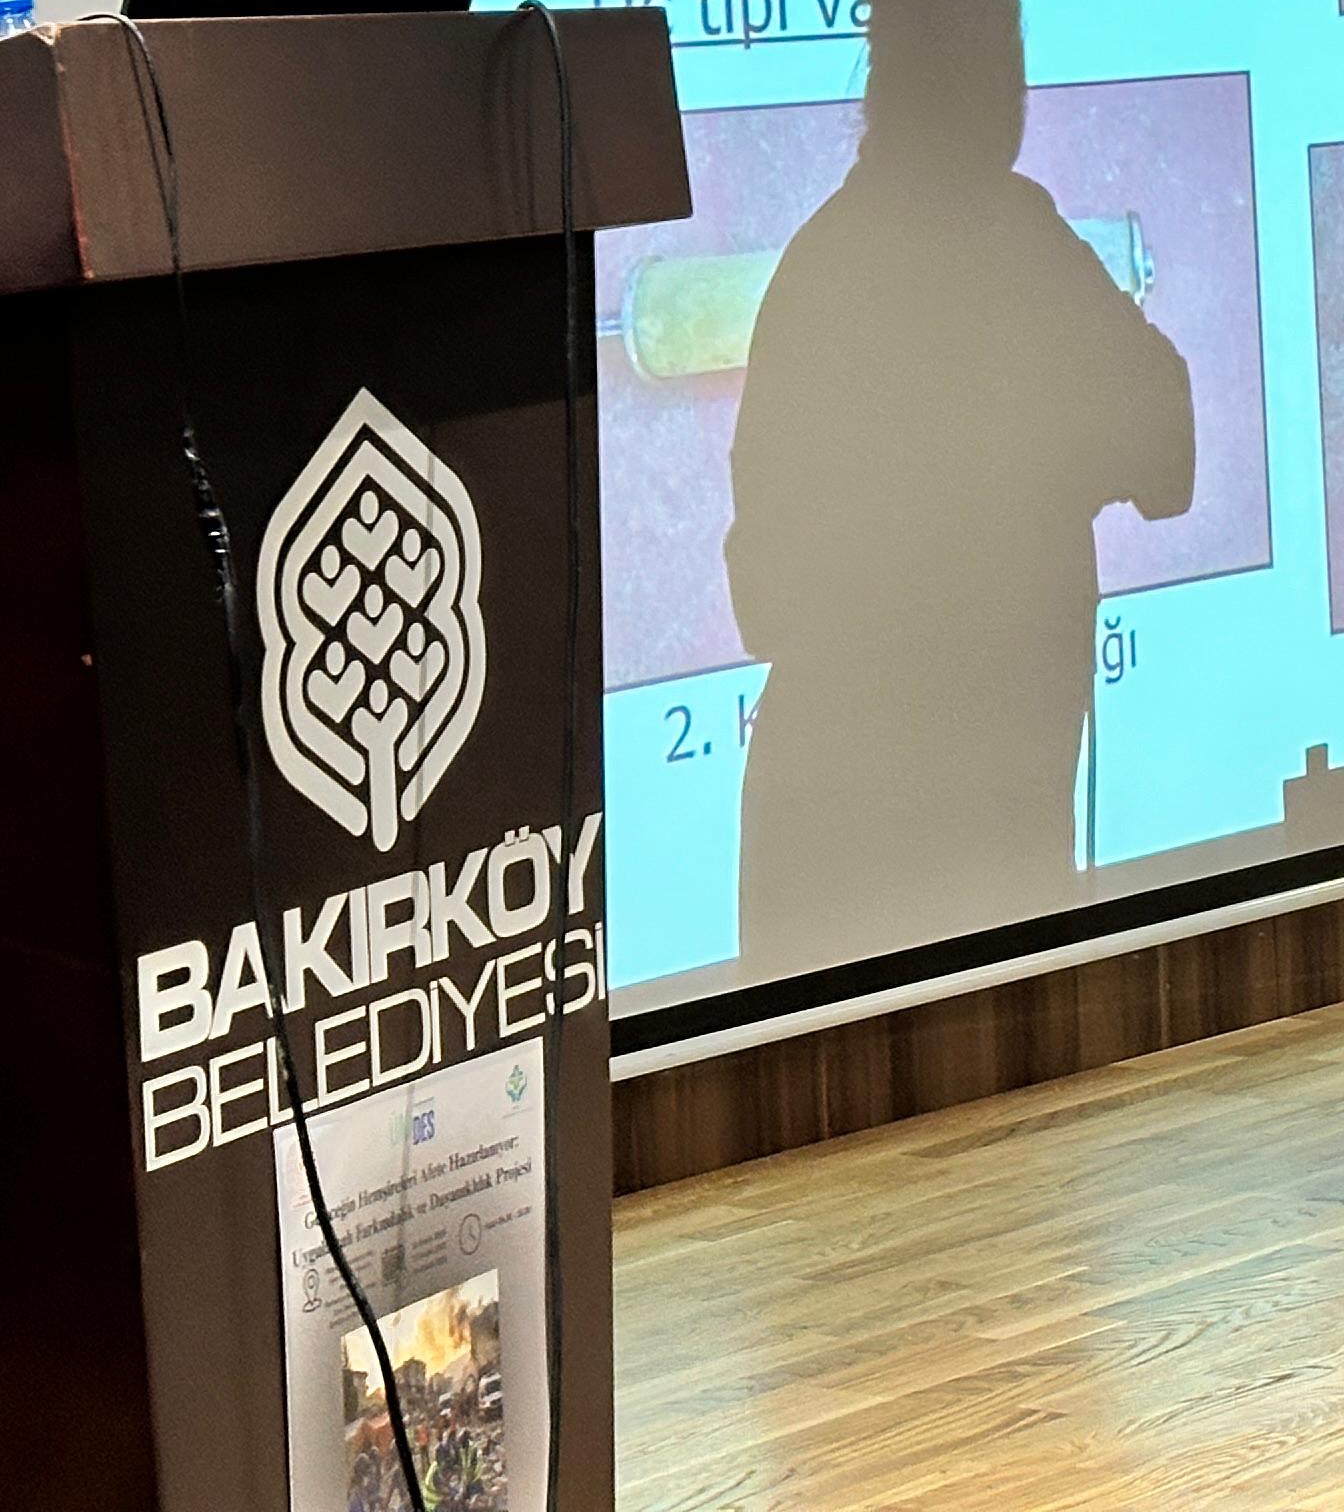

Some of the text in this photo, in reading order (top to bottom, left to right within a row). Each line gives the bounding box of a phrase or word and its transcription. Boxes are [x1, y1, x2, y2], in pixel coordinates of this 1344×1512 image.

[663, 703, 713, 764] 2.
[136, 811, 604, 1063] BAKIRKÖY
[141, 923, 606, 1173] BELEDİYESİ
